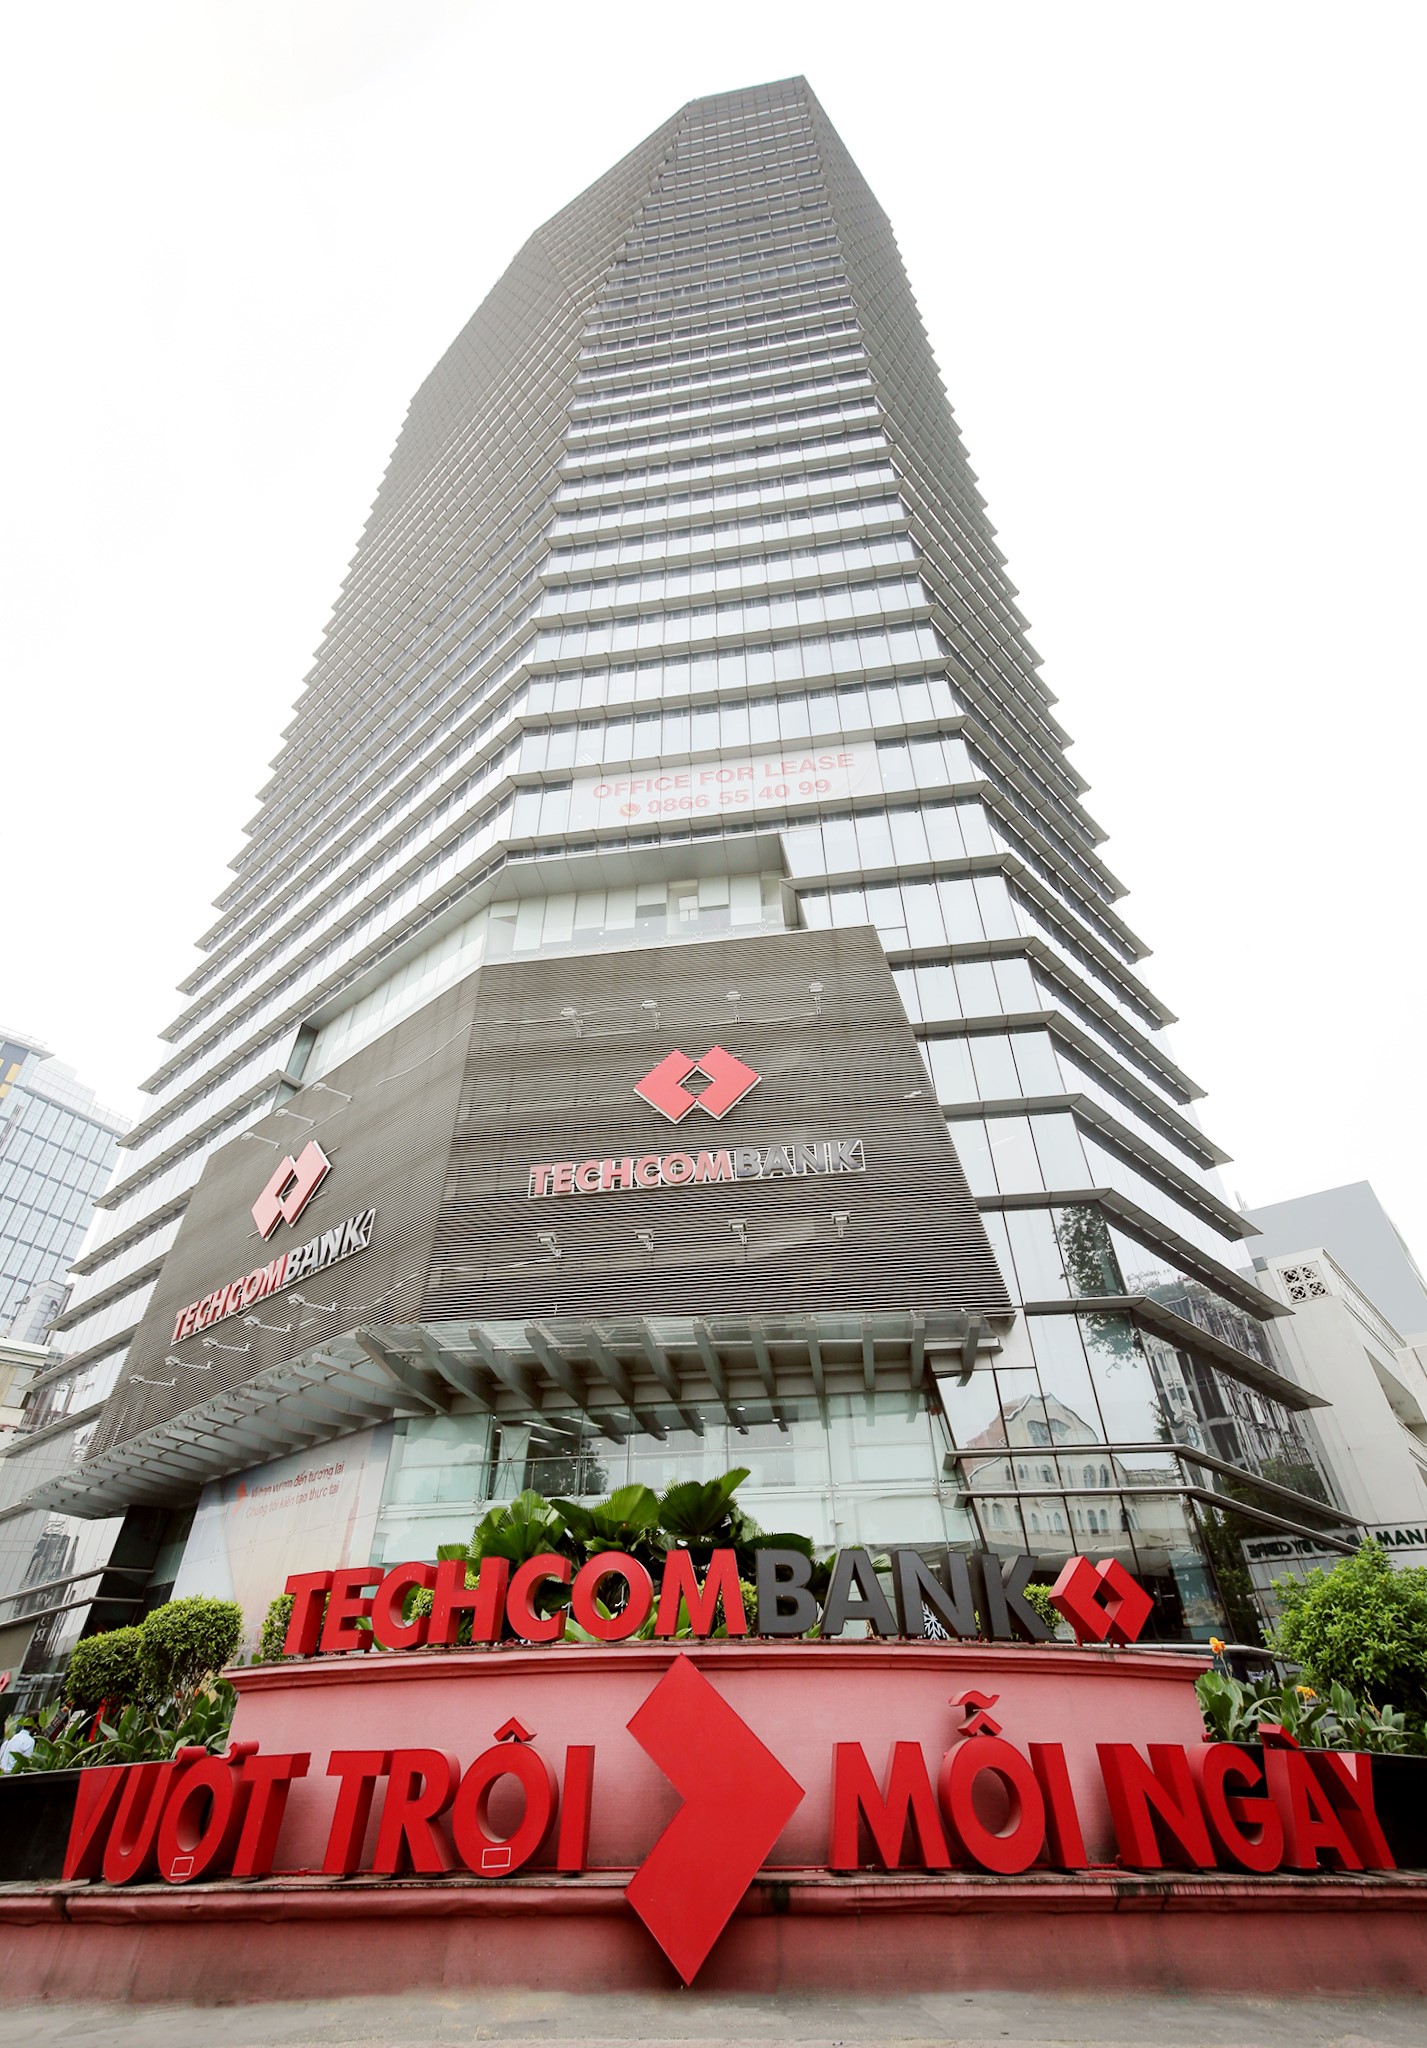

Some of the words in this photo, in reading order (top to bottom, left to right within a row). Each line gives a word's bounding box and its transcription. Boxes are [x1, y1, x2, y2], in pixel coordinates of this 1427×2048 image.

[592, 773, 690, 799] OFFICE
[699, 766, 755, 786] FOR
[764, 752, 856, 777] LEASE
[647, 793, 710, 814] 0866
[718, 788, 749, 805] 55
[758, 783, 790, 801] 40
[799, 778, 832, 796] 99
[528, 1139, 866, 1198] TECHCOMBANK
[170, 1208, 376, 1346] TECHCOMBANK
[284, 1547, 1058, 1656] TECHCOMBANK
[829, 1689, 1090, 1874] MỖI
[1096, 1723, 1397, 1873] NGÀY
